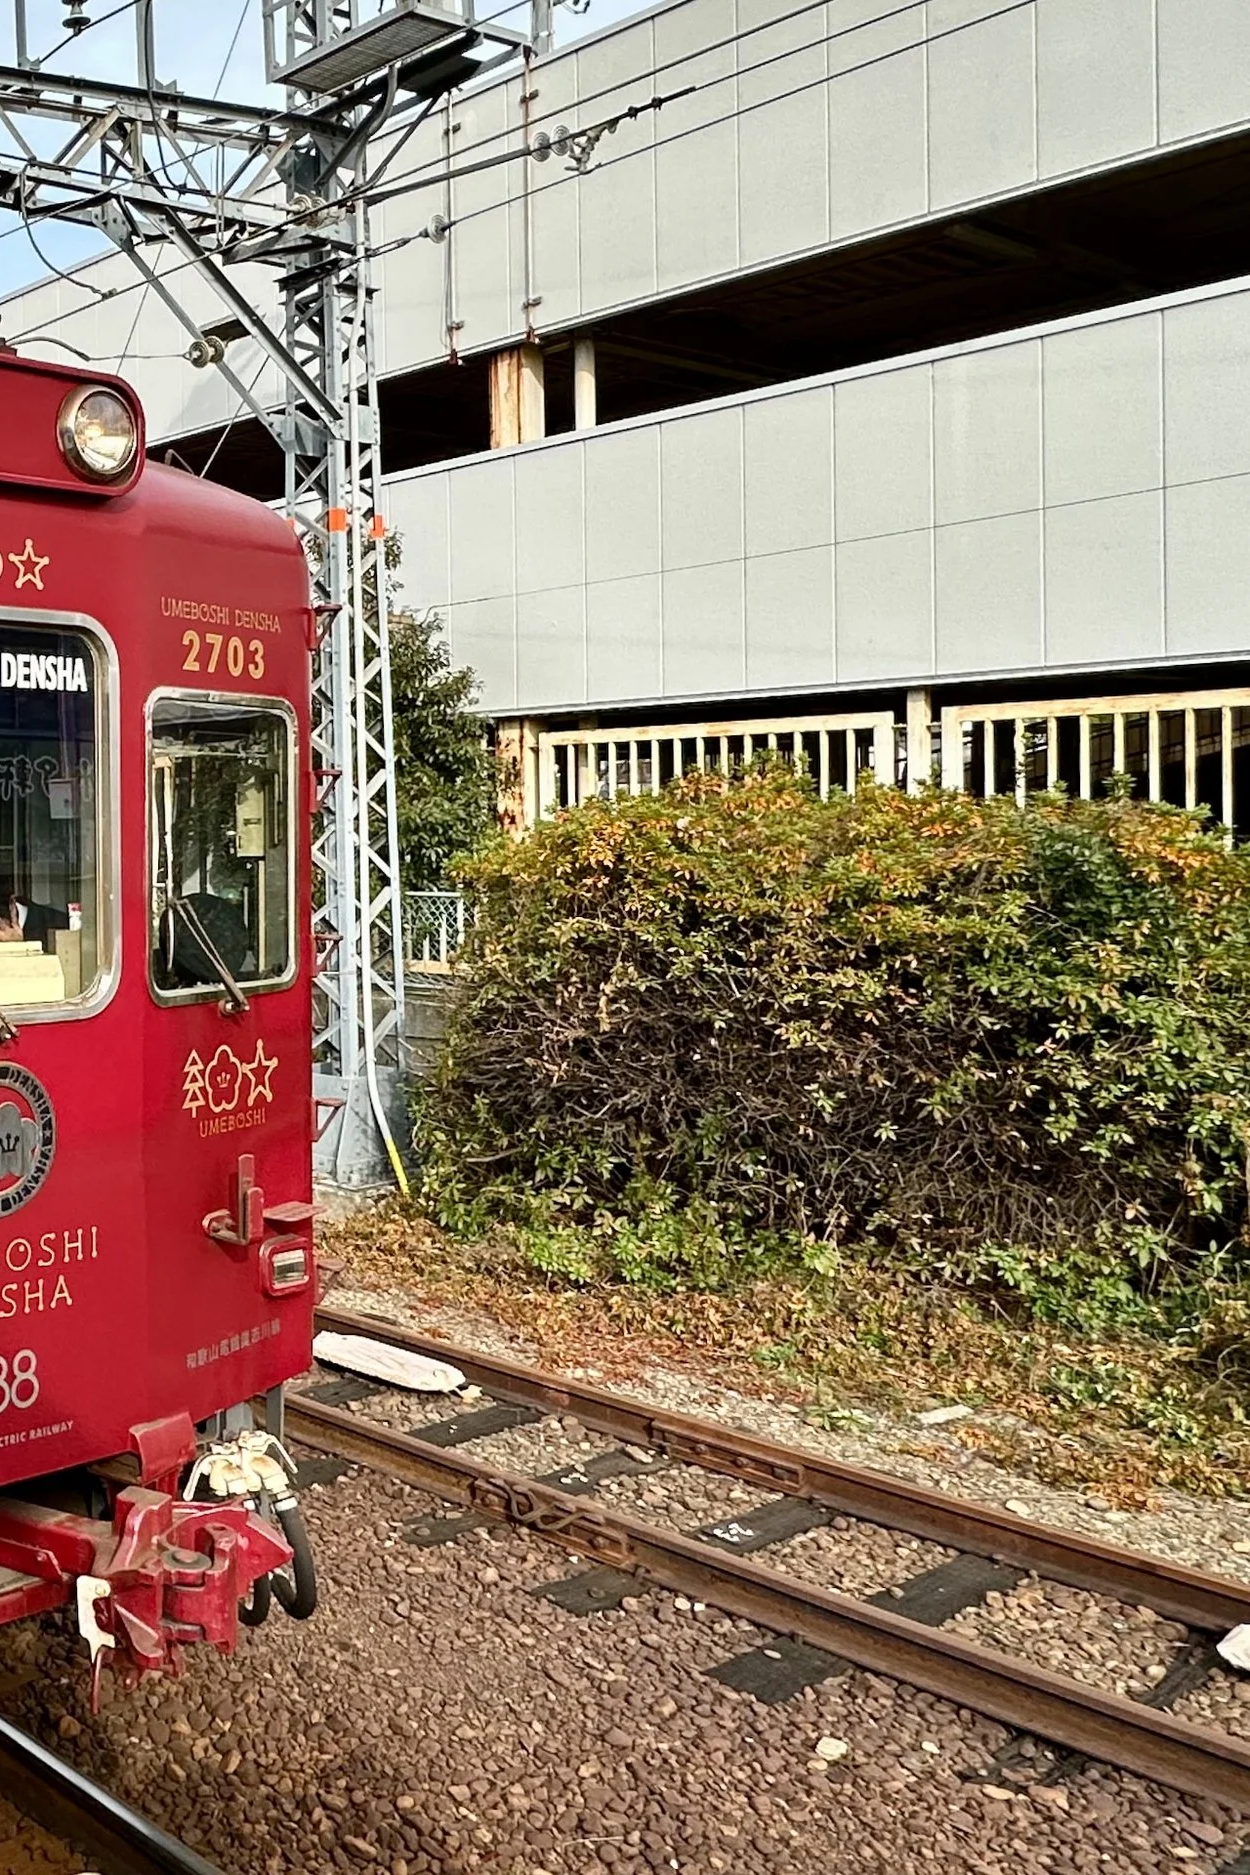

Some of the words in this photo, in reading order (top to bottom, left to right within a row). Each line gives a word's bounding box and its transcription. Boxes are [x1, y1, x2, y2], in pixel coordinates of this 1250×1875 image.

[161, 596, 230, 625] UMEBOSHI
[235, 608, 282, 633] DENSHA
[0, 652, 89, 693] DENSHA
[182, 629, 265, 680] 2703
[199, 1107, 266, 1138] UMEBOSHI
[29, 1420, 75, 1441] RAILWAY
